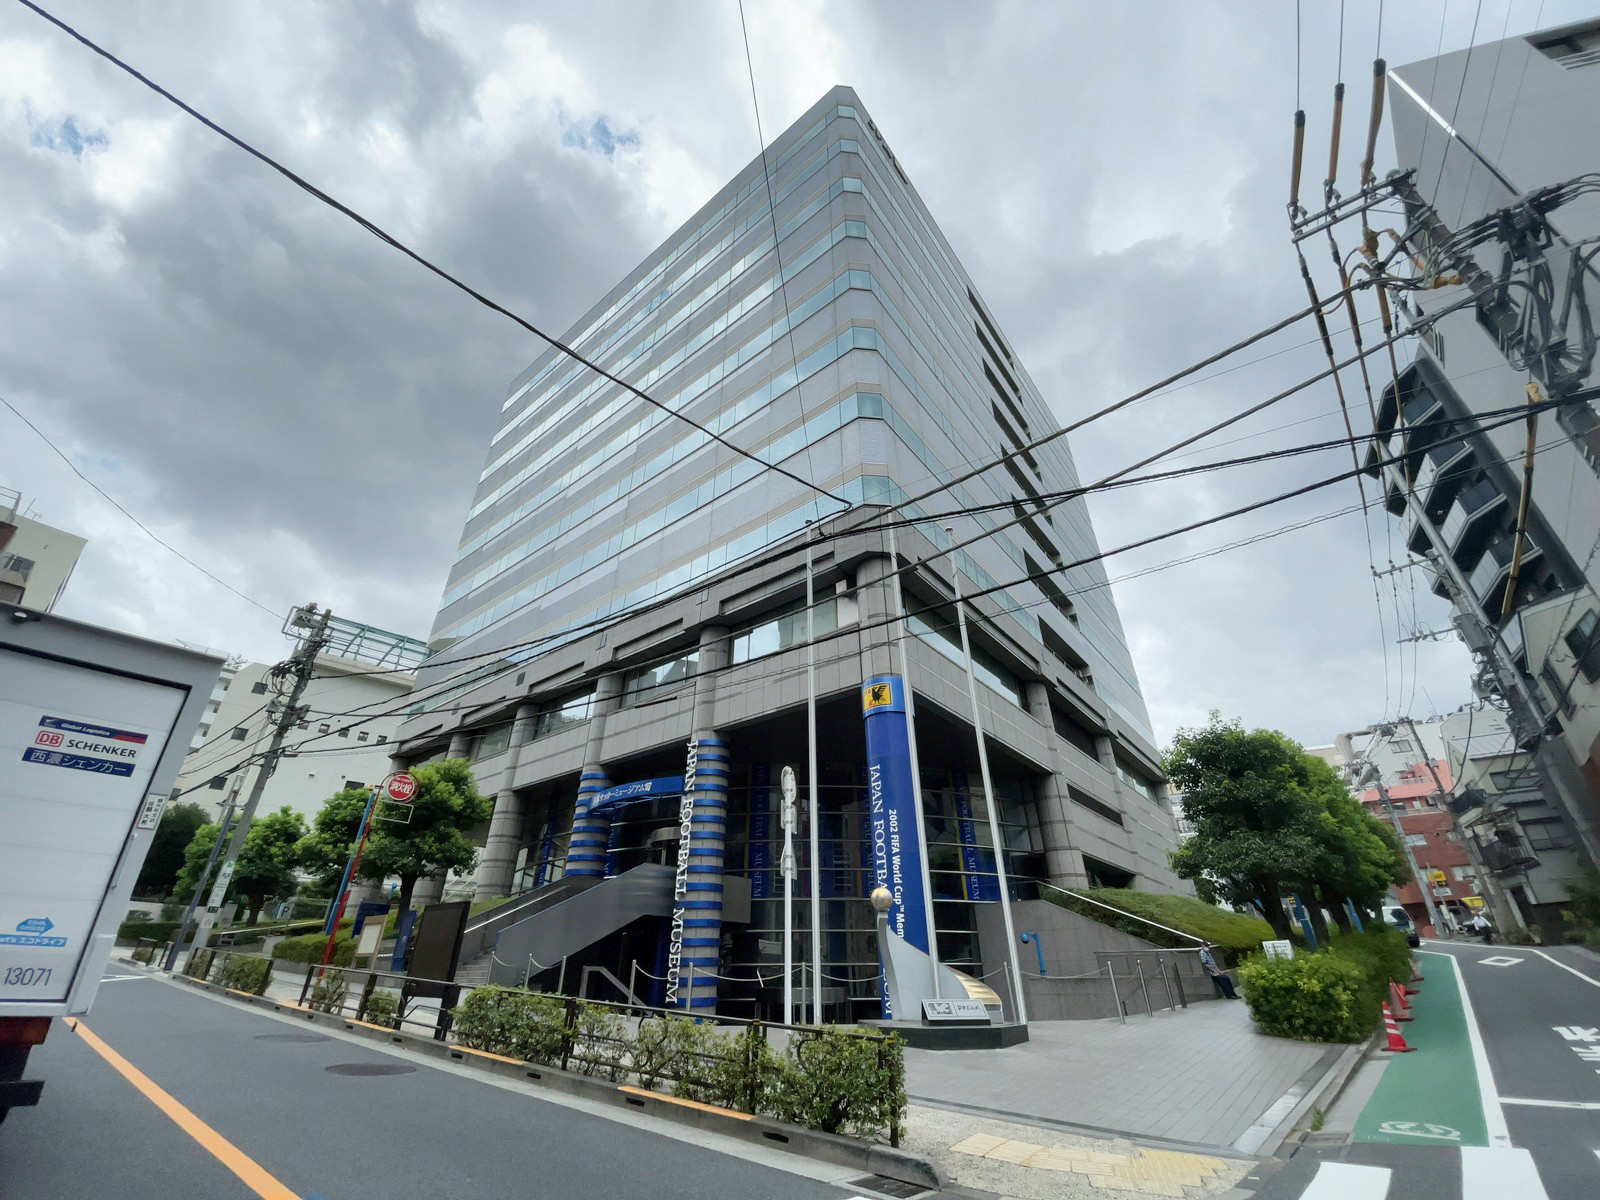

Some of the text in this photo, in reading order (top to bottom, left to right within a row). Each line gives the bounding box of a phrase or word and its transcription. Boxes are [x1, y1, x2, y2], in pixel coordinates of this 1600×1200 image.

[39, 732, 137, 758] DB SCHENKER
[30, 750, 128, 773] 西濃シェンカー
[869, 764, 884, 813] JAPAN
[888, 809, 898, 833] 2002
[890, 835, 900, 854] FIFA
[665, 740, 699, 1004] JAPAN FOOTBALL MUSEUM
[891, 855, 903, 884] World
[4, 967, 53, 986] 13071
